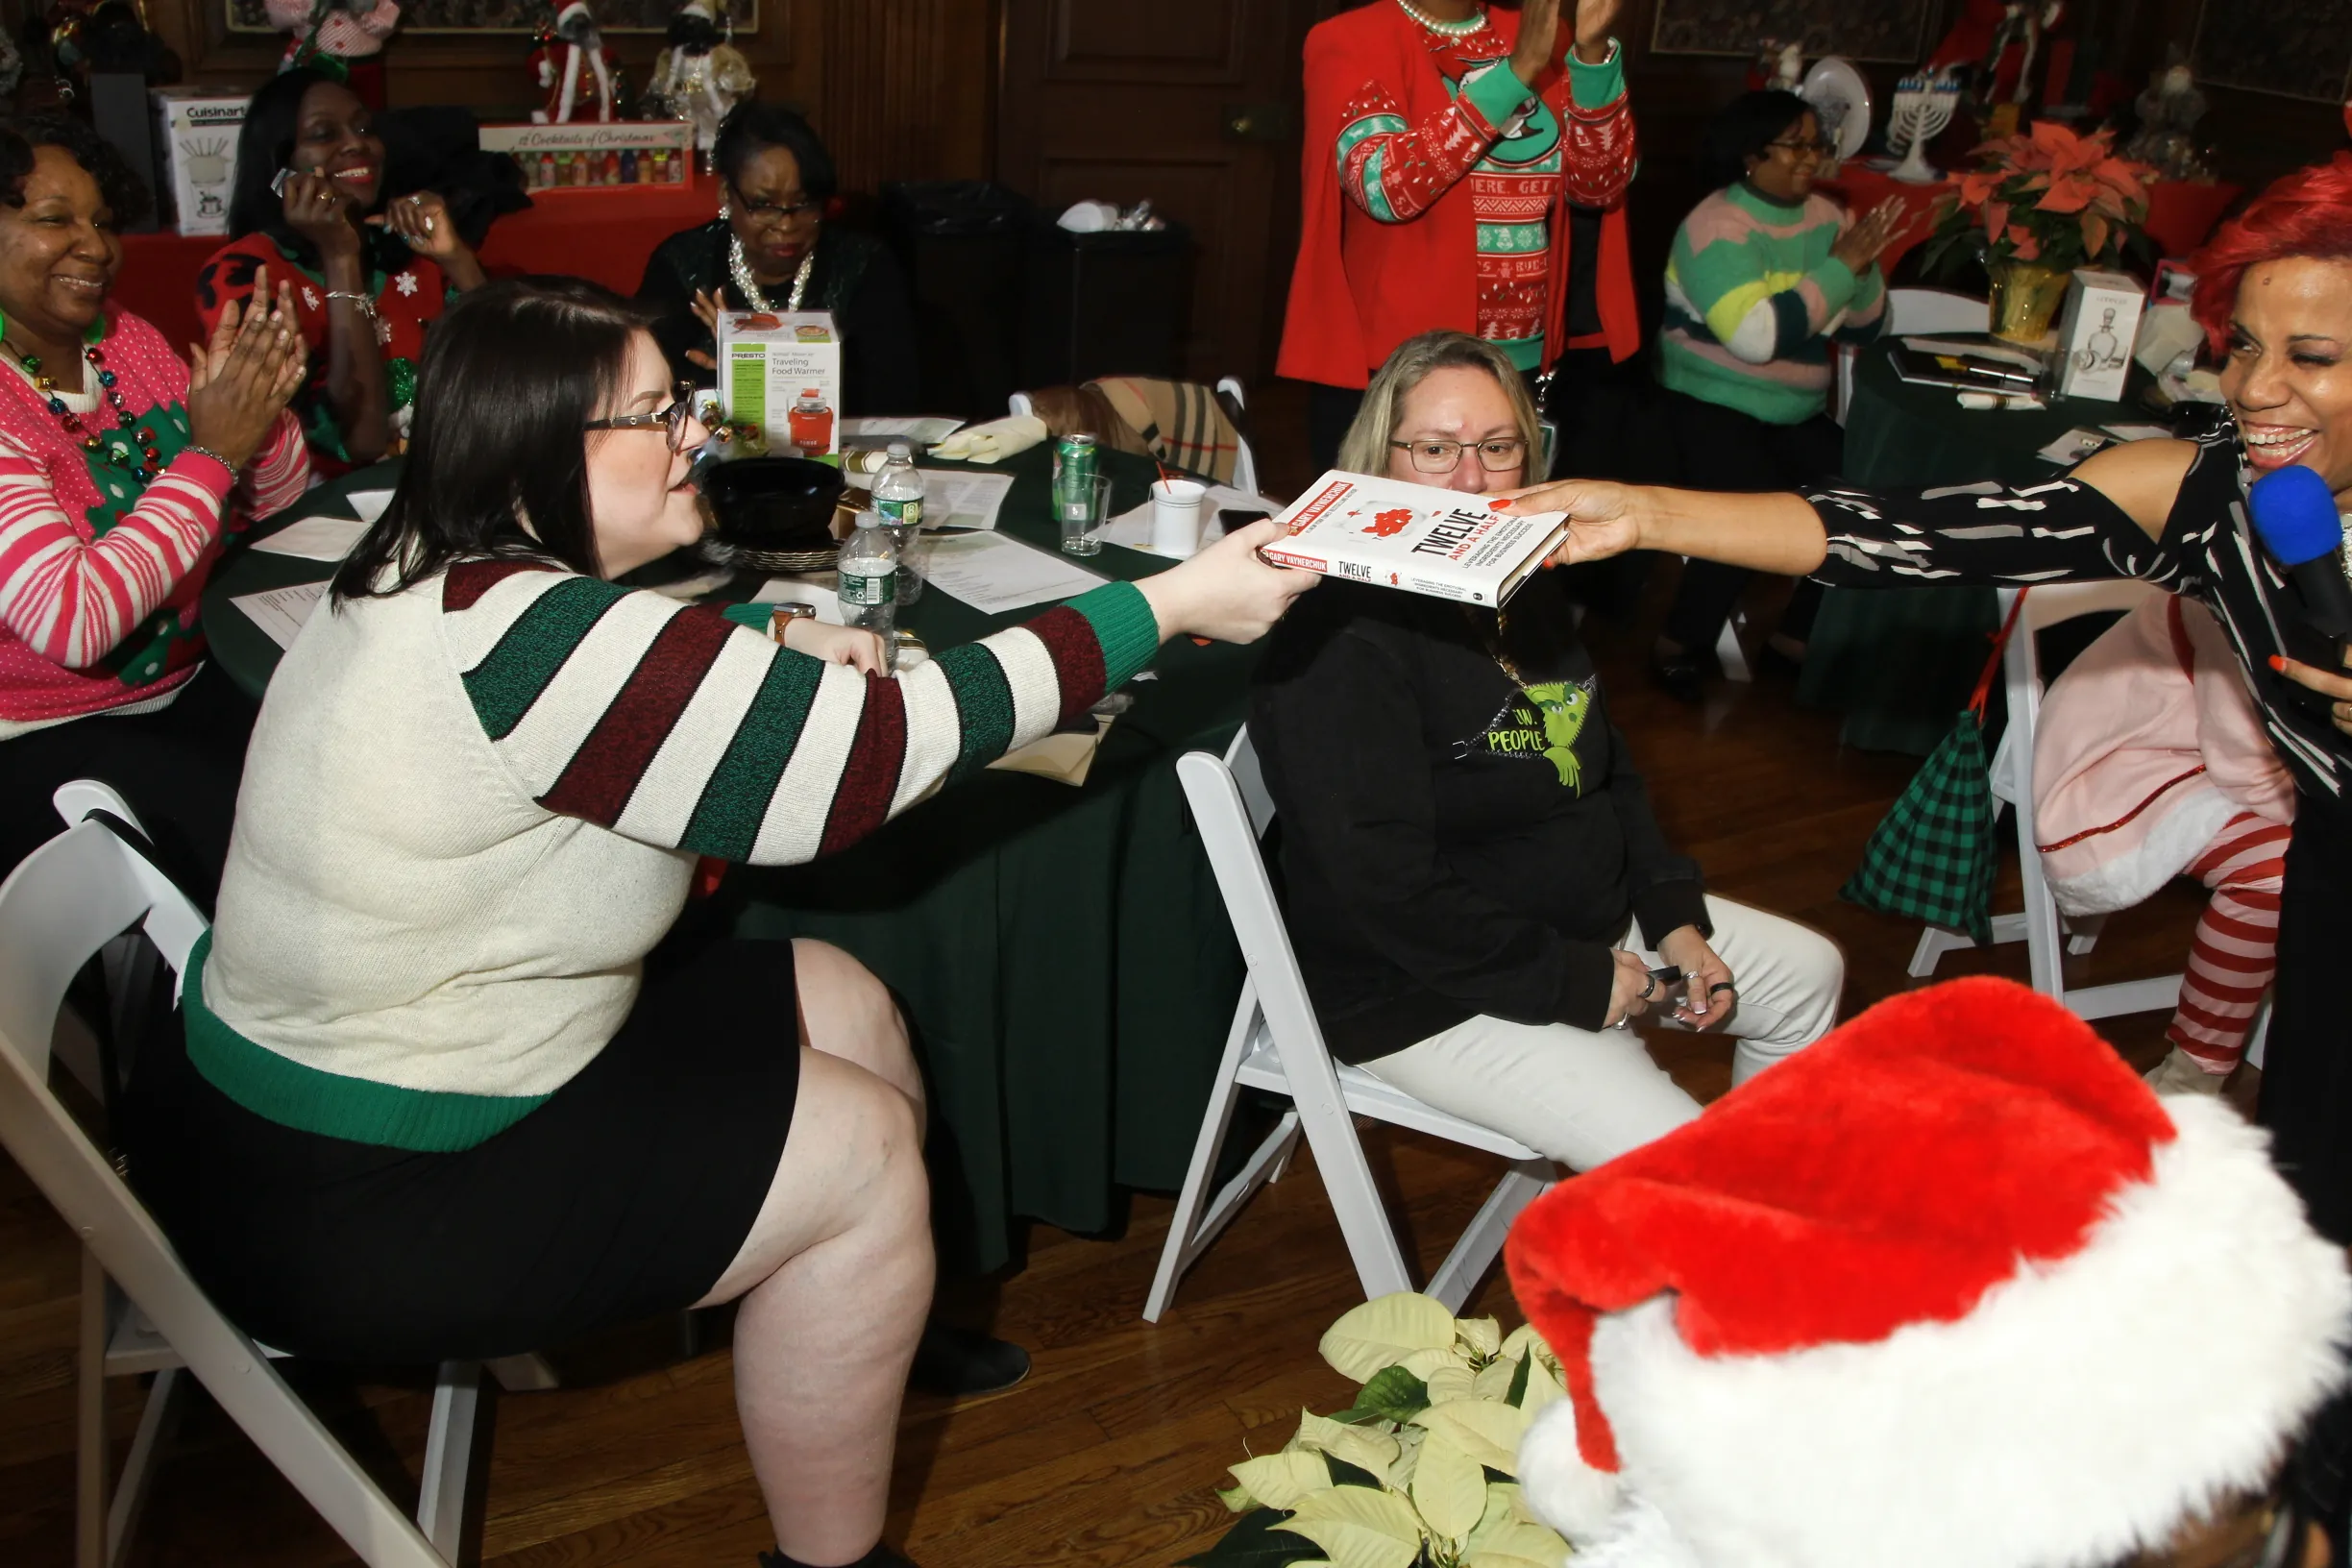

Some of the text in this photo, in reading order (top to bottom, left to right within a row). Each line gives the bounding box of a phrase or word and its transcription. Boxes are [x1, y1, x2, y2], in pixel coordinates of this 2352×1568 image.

[186, 107, 245, 118] Cuisinart
[530, 133, 583, 146] Cocktails
[598, 131, 654, 144] Christmas
[1518, 180, 1551, 194] GET
[772, 357, 809, 368] Traveling
[1292, 482, 1350, 527] GARY VAYNERCHUK
[1410, 508, 1488, 556] TWELVE
[1447, 543, 1471, 561] AND
[1473, 515, 1499, 536] HALF
[1475, 520, 1527, 567] INGREDIENTS NECESSARY
[1462, 543, 1491, 569] LEVERAGING
[1486, 535, 1499, 545] THE
[1485, 523, 1533, 567] FOR BUSINESS SUCCESS
[1269, 551, 1327, 571] GARY VAYNERCHUK
[1338, 560, 1372, 578] TWELVE
[1488, 729, 1546, 752] PEOPLE
